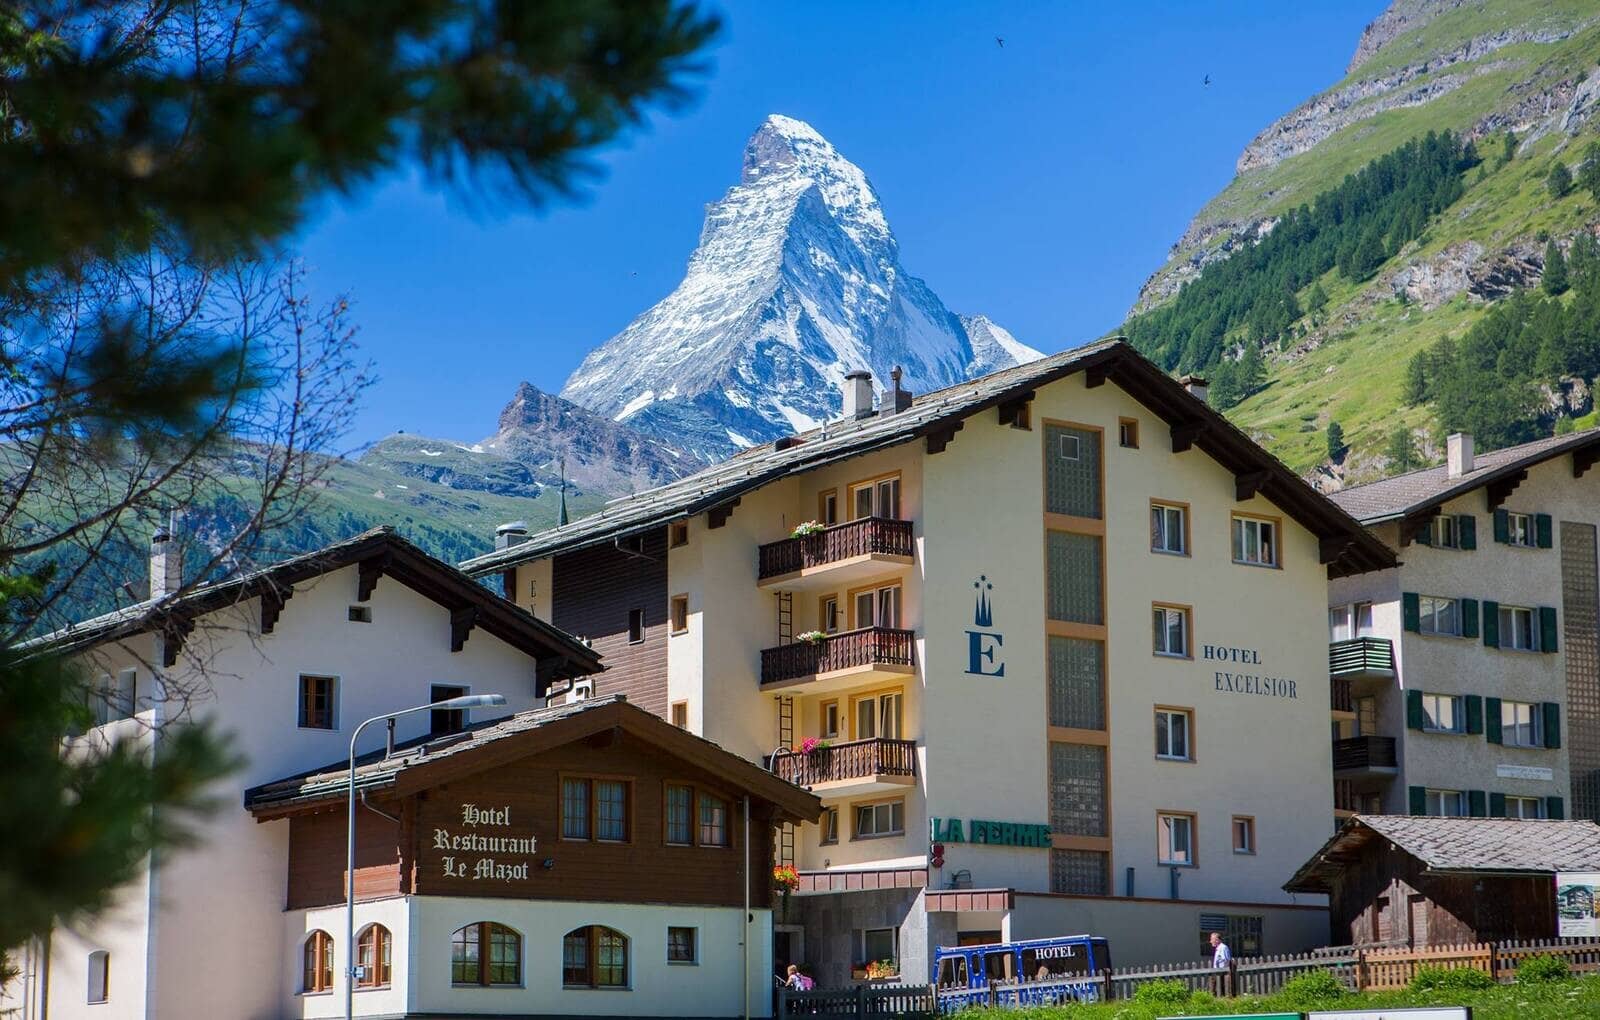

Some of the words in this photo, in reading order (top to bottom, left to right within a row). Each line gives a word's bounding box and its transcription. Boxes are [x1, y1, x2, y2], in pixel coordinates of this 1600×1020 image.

[964, 630, 1005, 678] E
[1203, 644, 1262, 665] HOTEL
[1215, 672, 1298, 699] EXCELSIOR
[462, 803, 511, 827] Hotel
[432, 828, 537, 855] Restaurant
[930, 817, 966, 843] LA
[970, 819, 1053, 849] FERME
[441, 855, 467, 878] Le
[472, 857, 529, 883] Mazot
[1034, 946, 1076, 960] HOTEL
